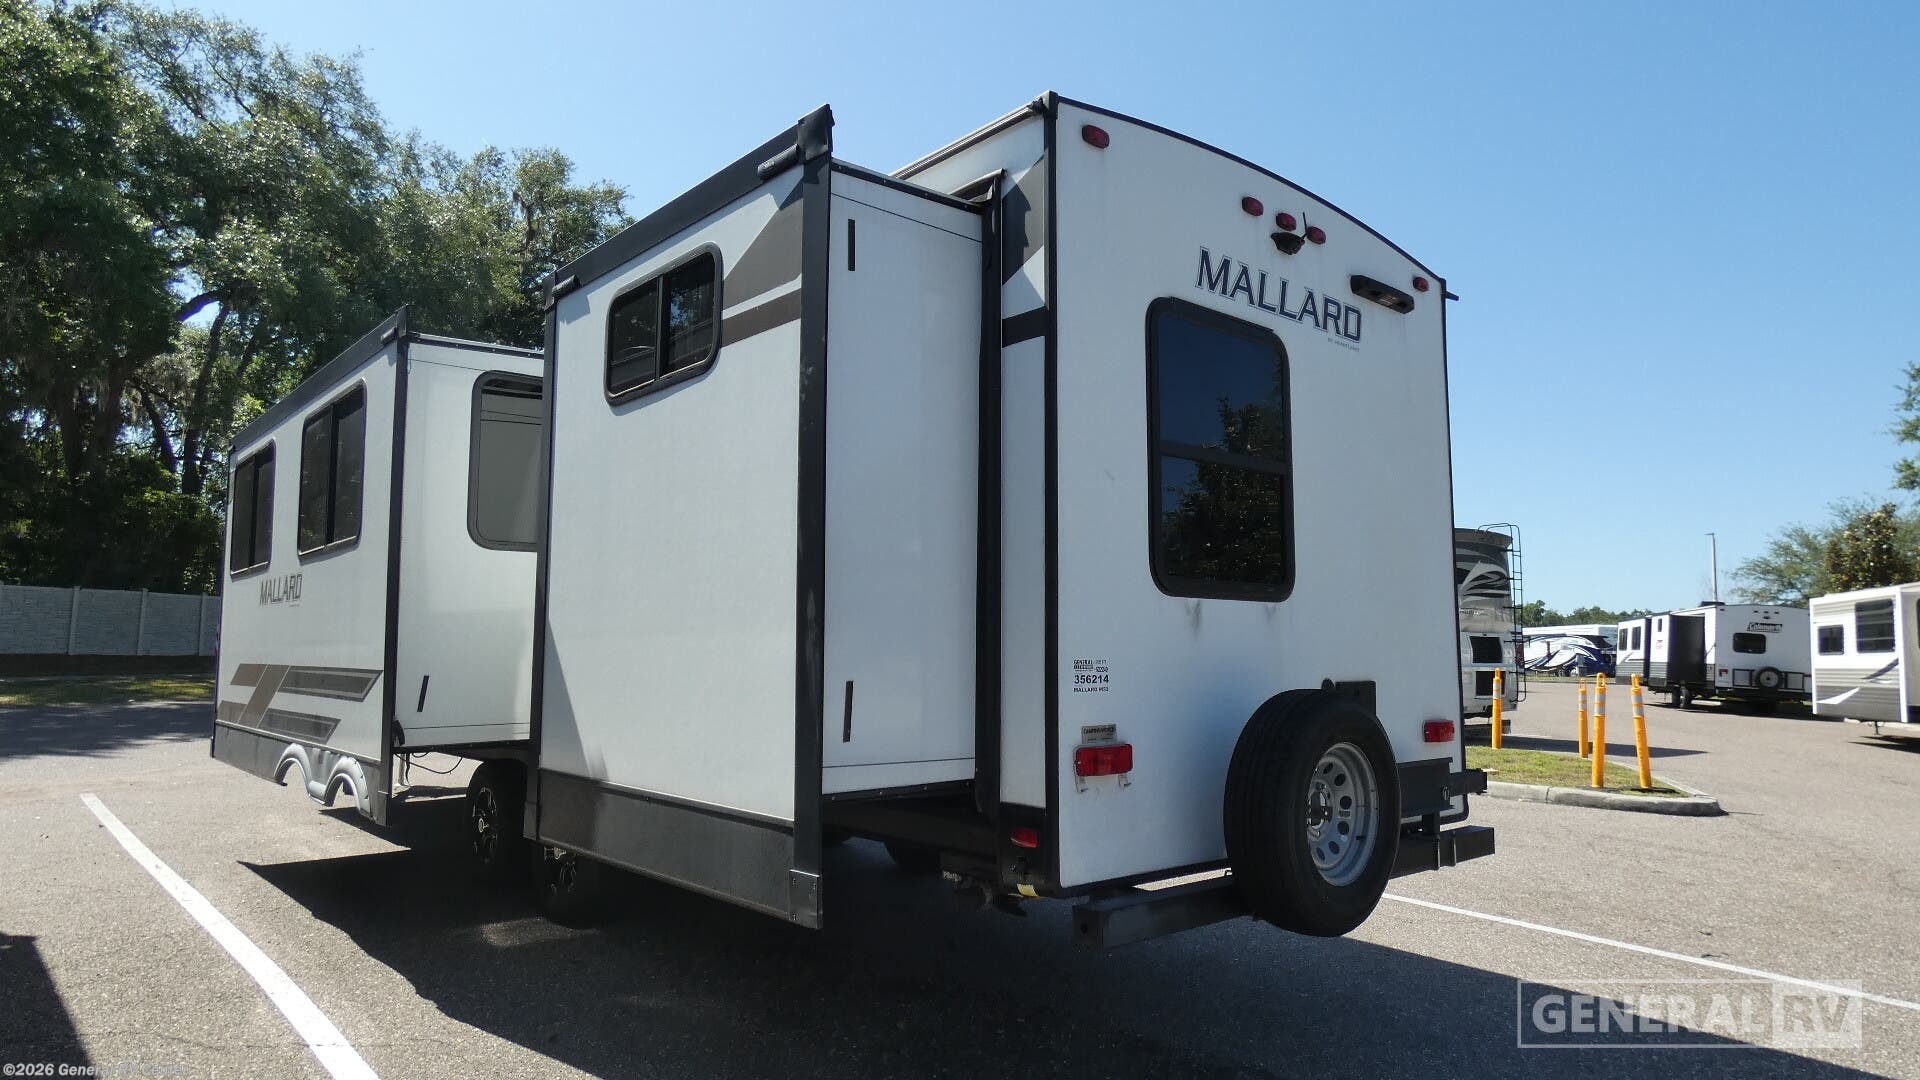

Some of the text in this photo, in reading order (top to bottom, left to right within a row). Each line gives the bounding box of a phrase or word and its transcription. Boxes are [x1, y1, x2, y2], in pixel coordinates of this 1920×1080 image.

[1195, 246, 1362, 343] MALLARD
[259, 573, 303, 606] MALLARD
[1074, 674, 1109, 684] 356214
